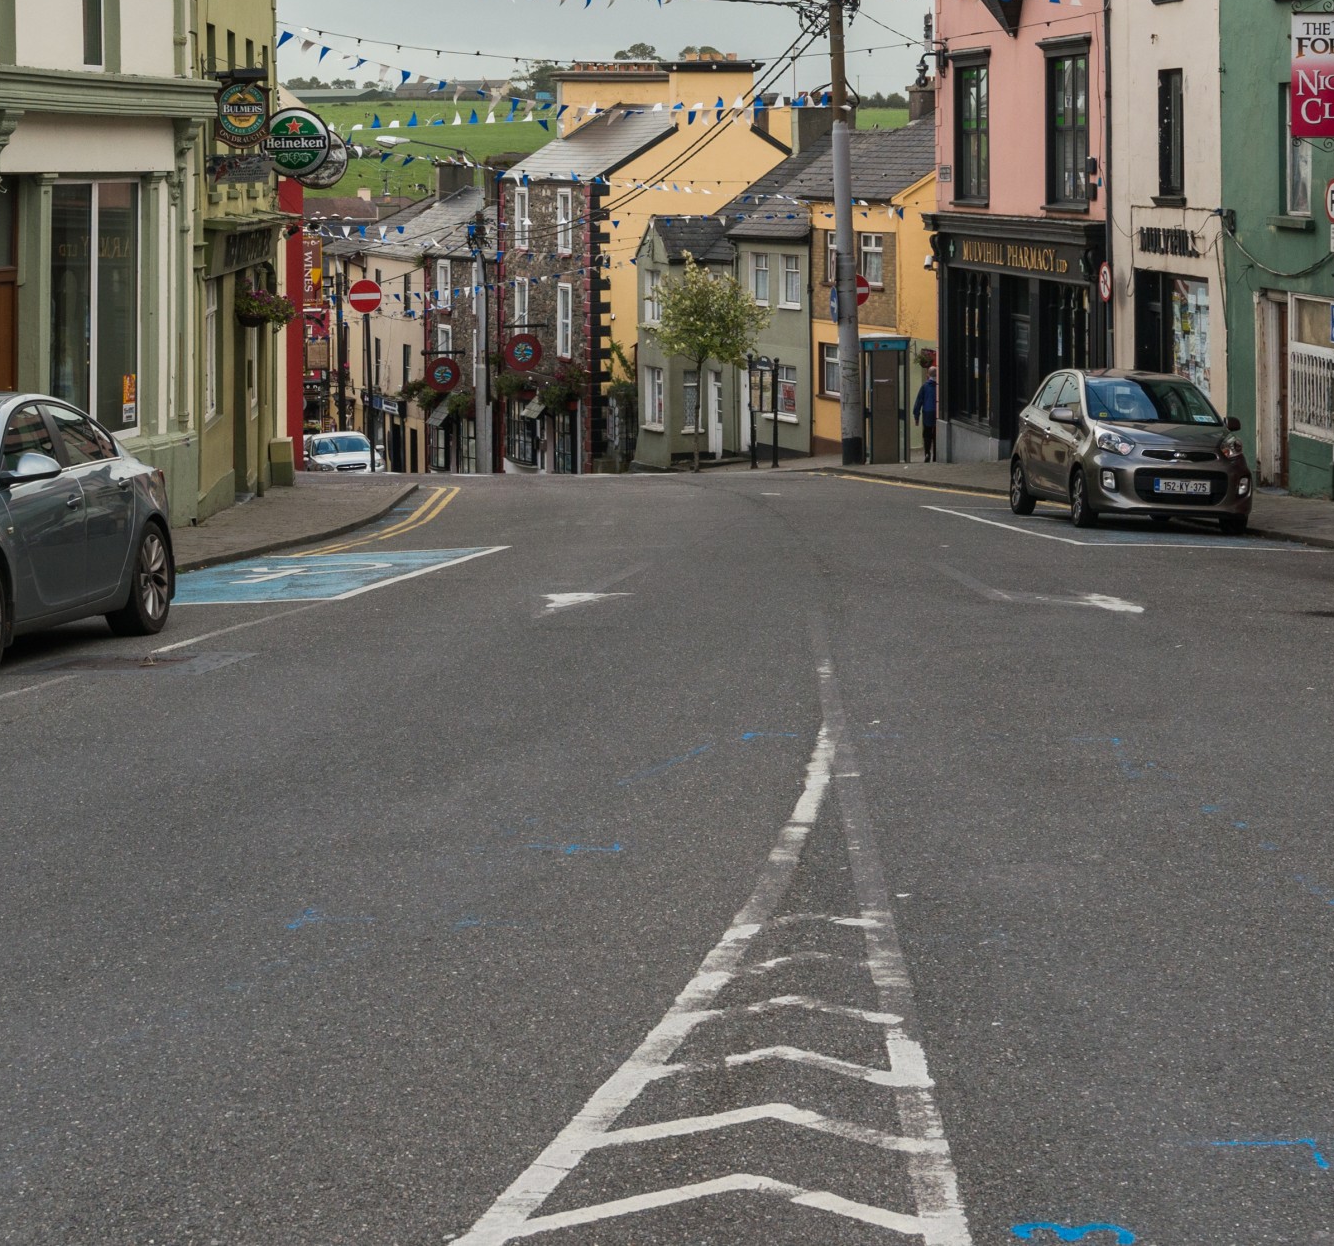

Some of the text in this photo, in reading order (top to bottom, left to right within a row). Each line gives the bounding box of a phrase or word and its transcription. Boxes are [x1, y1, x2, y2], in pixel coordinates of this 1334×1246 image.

[1303, 23, 1330, 35] THE
[223, 104, 263, 113] BULMERS
[267, 137, 324, 148] Heineken
[963, 240, 1004, 265] MULVIHILL
[1007, 245, 1055, 272] PHARMACY
[303, 251, 313, 292] WINES
